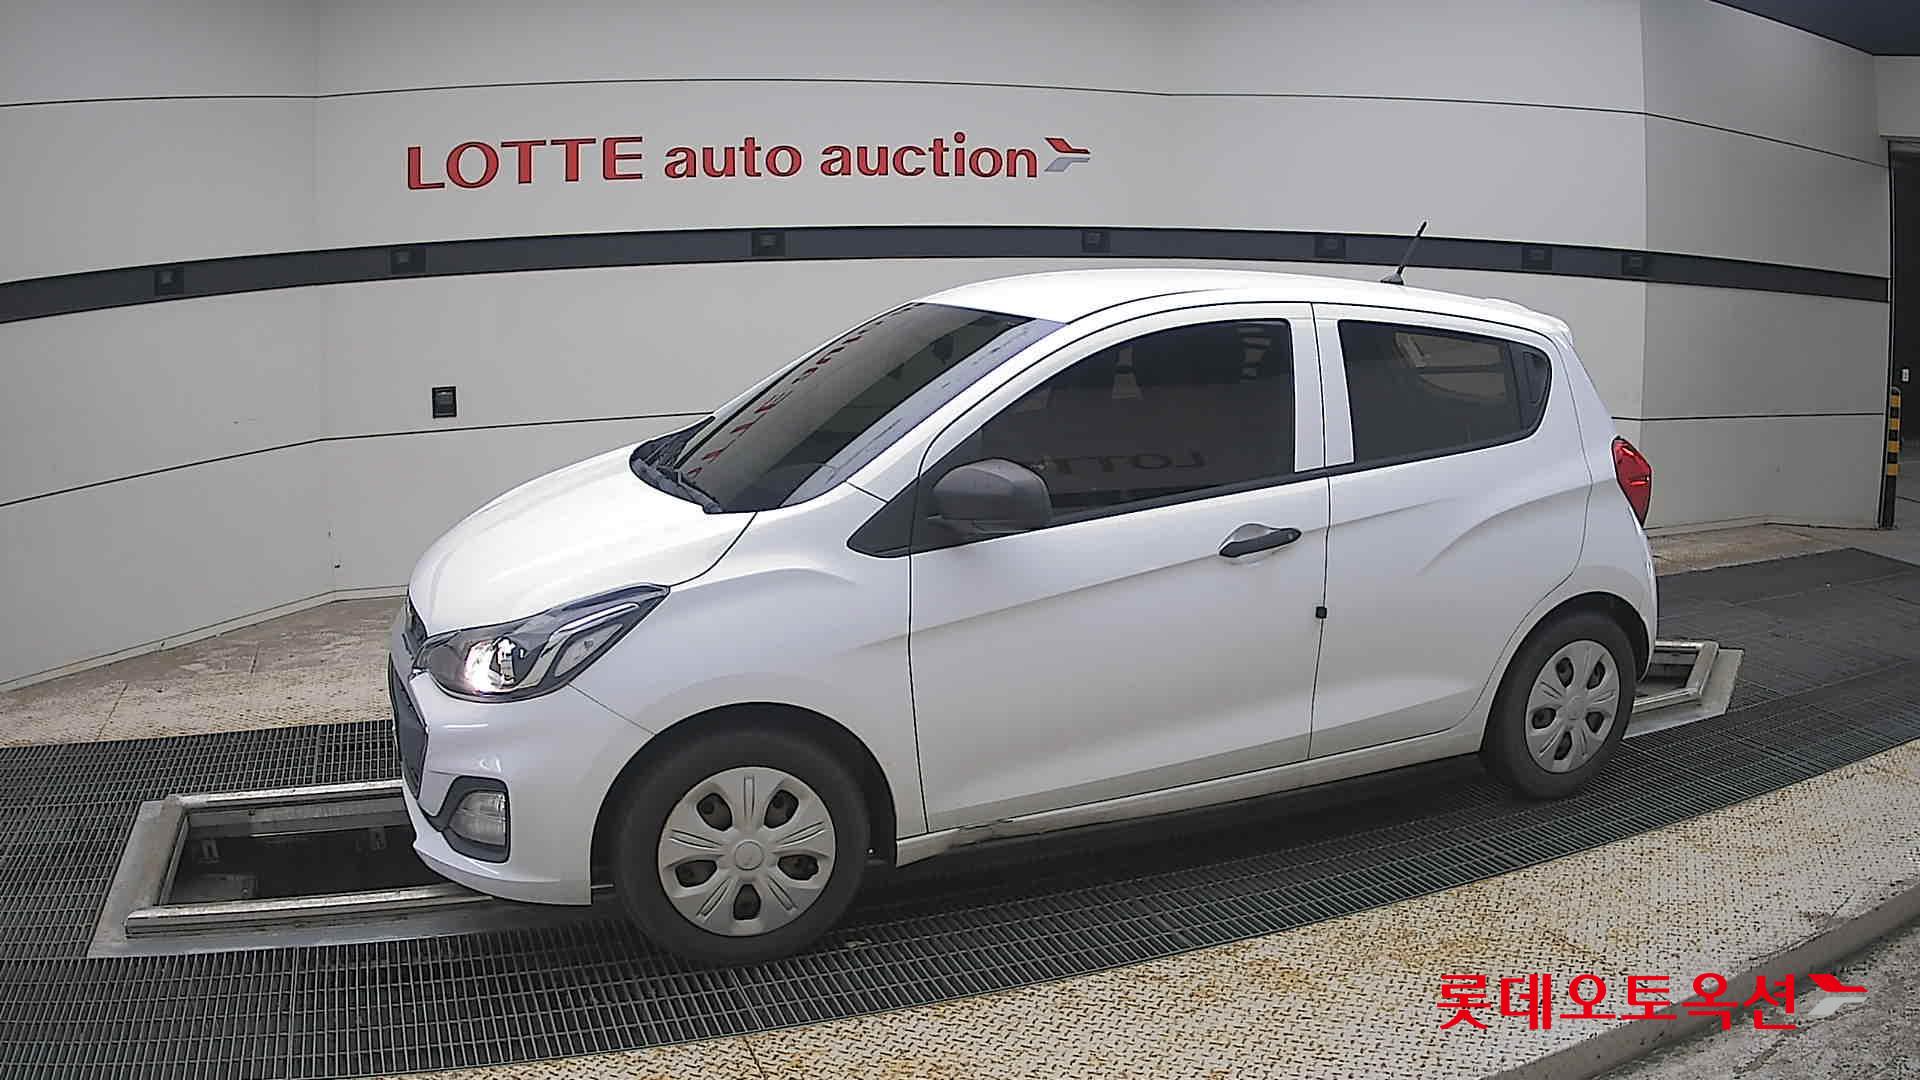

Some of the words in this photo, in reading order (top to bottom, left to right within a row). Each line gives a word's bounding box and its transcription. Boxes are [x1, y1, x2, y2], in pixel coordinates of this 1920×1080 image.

[407, 136, 642, 191] LOTTE
[664, 136, 803, 178] auto
[819, 132, 1038, 177] auction
